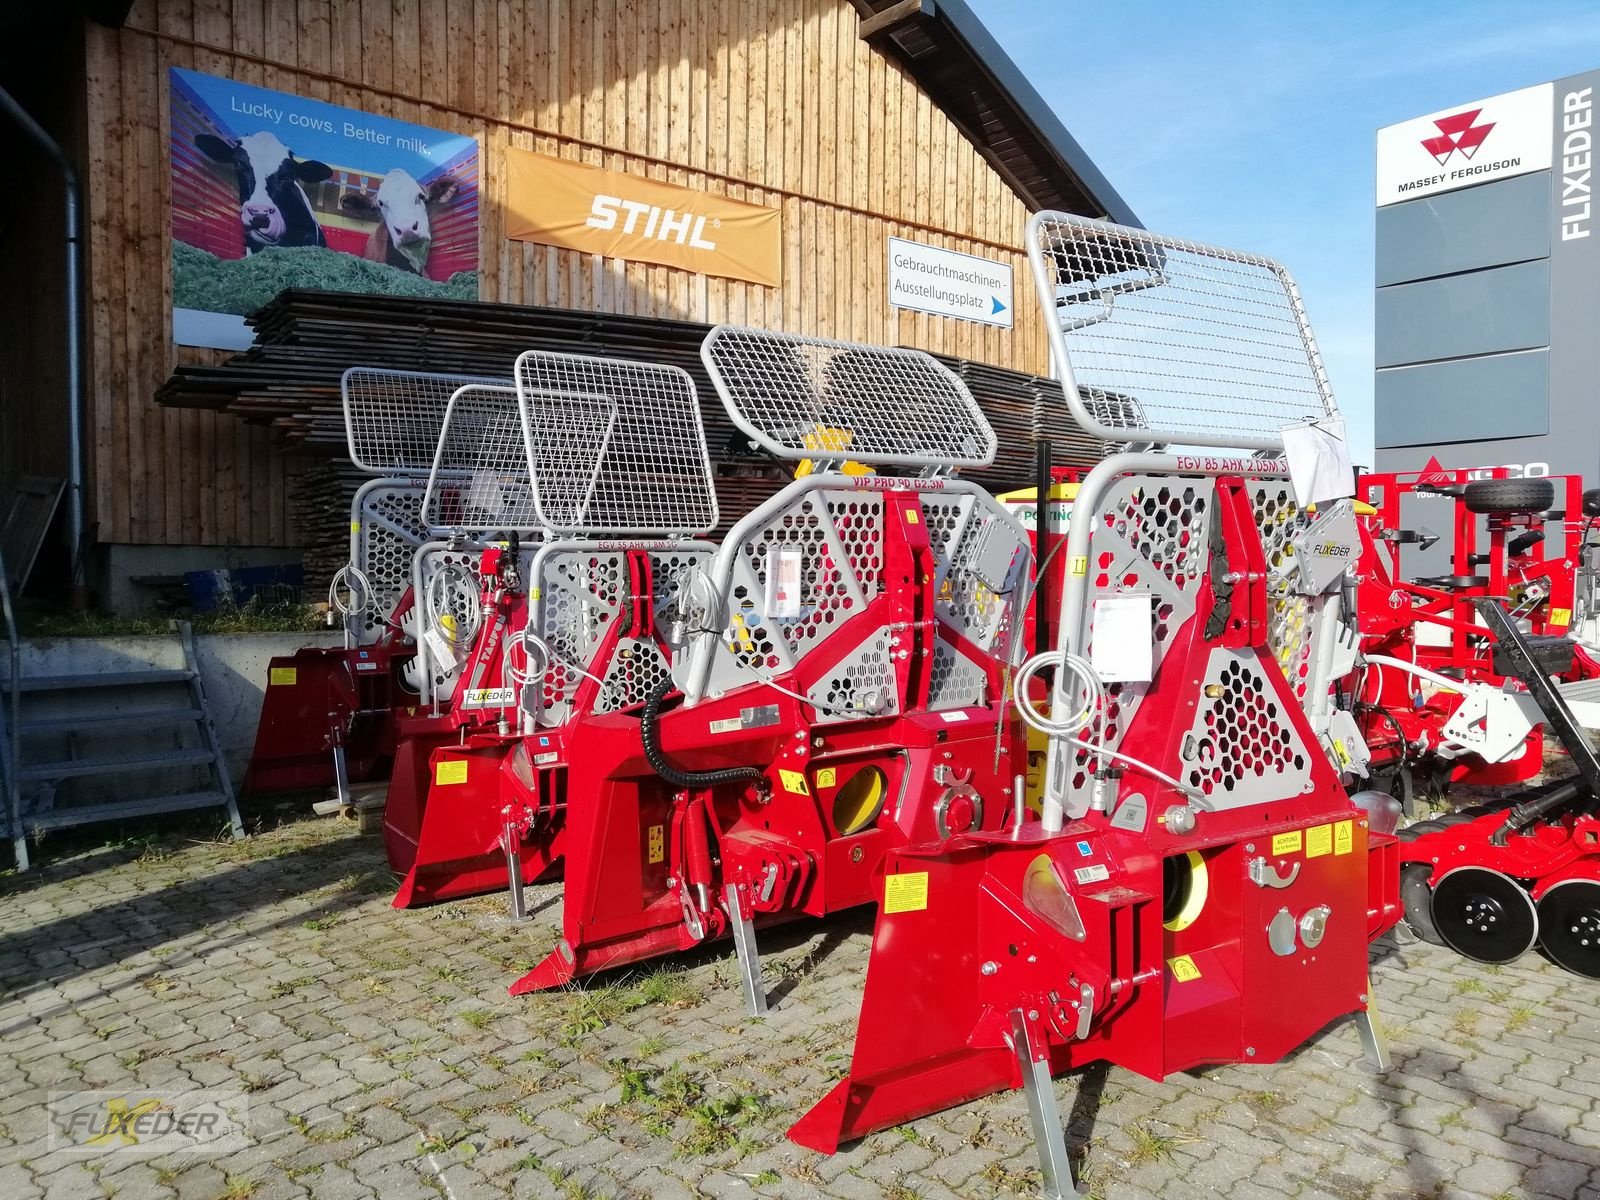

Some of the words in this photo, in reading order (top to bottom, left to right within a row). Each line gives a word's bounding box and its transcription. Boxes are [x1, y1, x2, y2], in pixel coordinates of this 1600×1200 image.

[231, 96, 283, 124] Lucky
[289, 113, 337, 134] cows.
[344, 122, 392, 146] Better
[396, 137, 432, 155] milk.
[1398, 174, 1446, 193] MASSEY
[1451, 157, 1521, 180] FERGUSON
[1562, 87, 1592, 241] FLIXEDER
[585, 194, 716, 250] STIHL
[895, 278, 984, 308] Ausstellungsplatz
[1177, 456, 1200, 470] EGV
[1205, 457, 1219, 471] 85
[1221, 458, 1244, 472] AHK
[1247, 459, 1279, 473] 2.05M
[1281, 461, 1289, 473] S
[853, 477, 871, 487] VIP
[874, 477, 896, 488] PRO
[598, 541, 615, 550] EGV
[617, 541, 627, 550] 55
[629, 541, 645, 550] AHK
[1313, 544, 1350, 557] FLIXEDER
